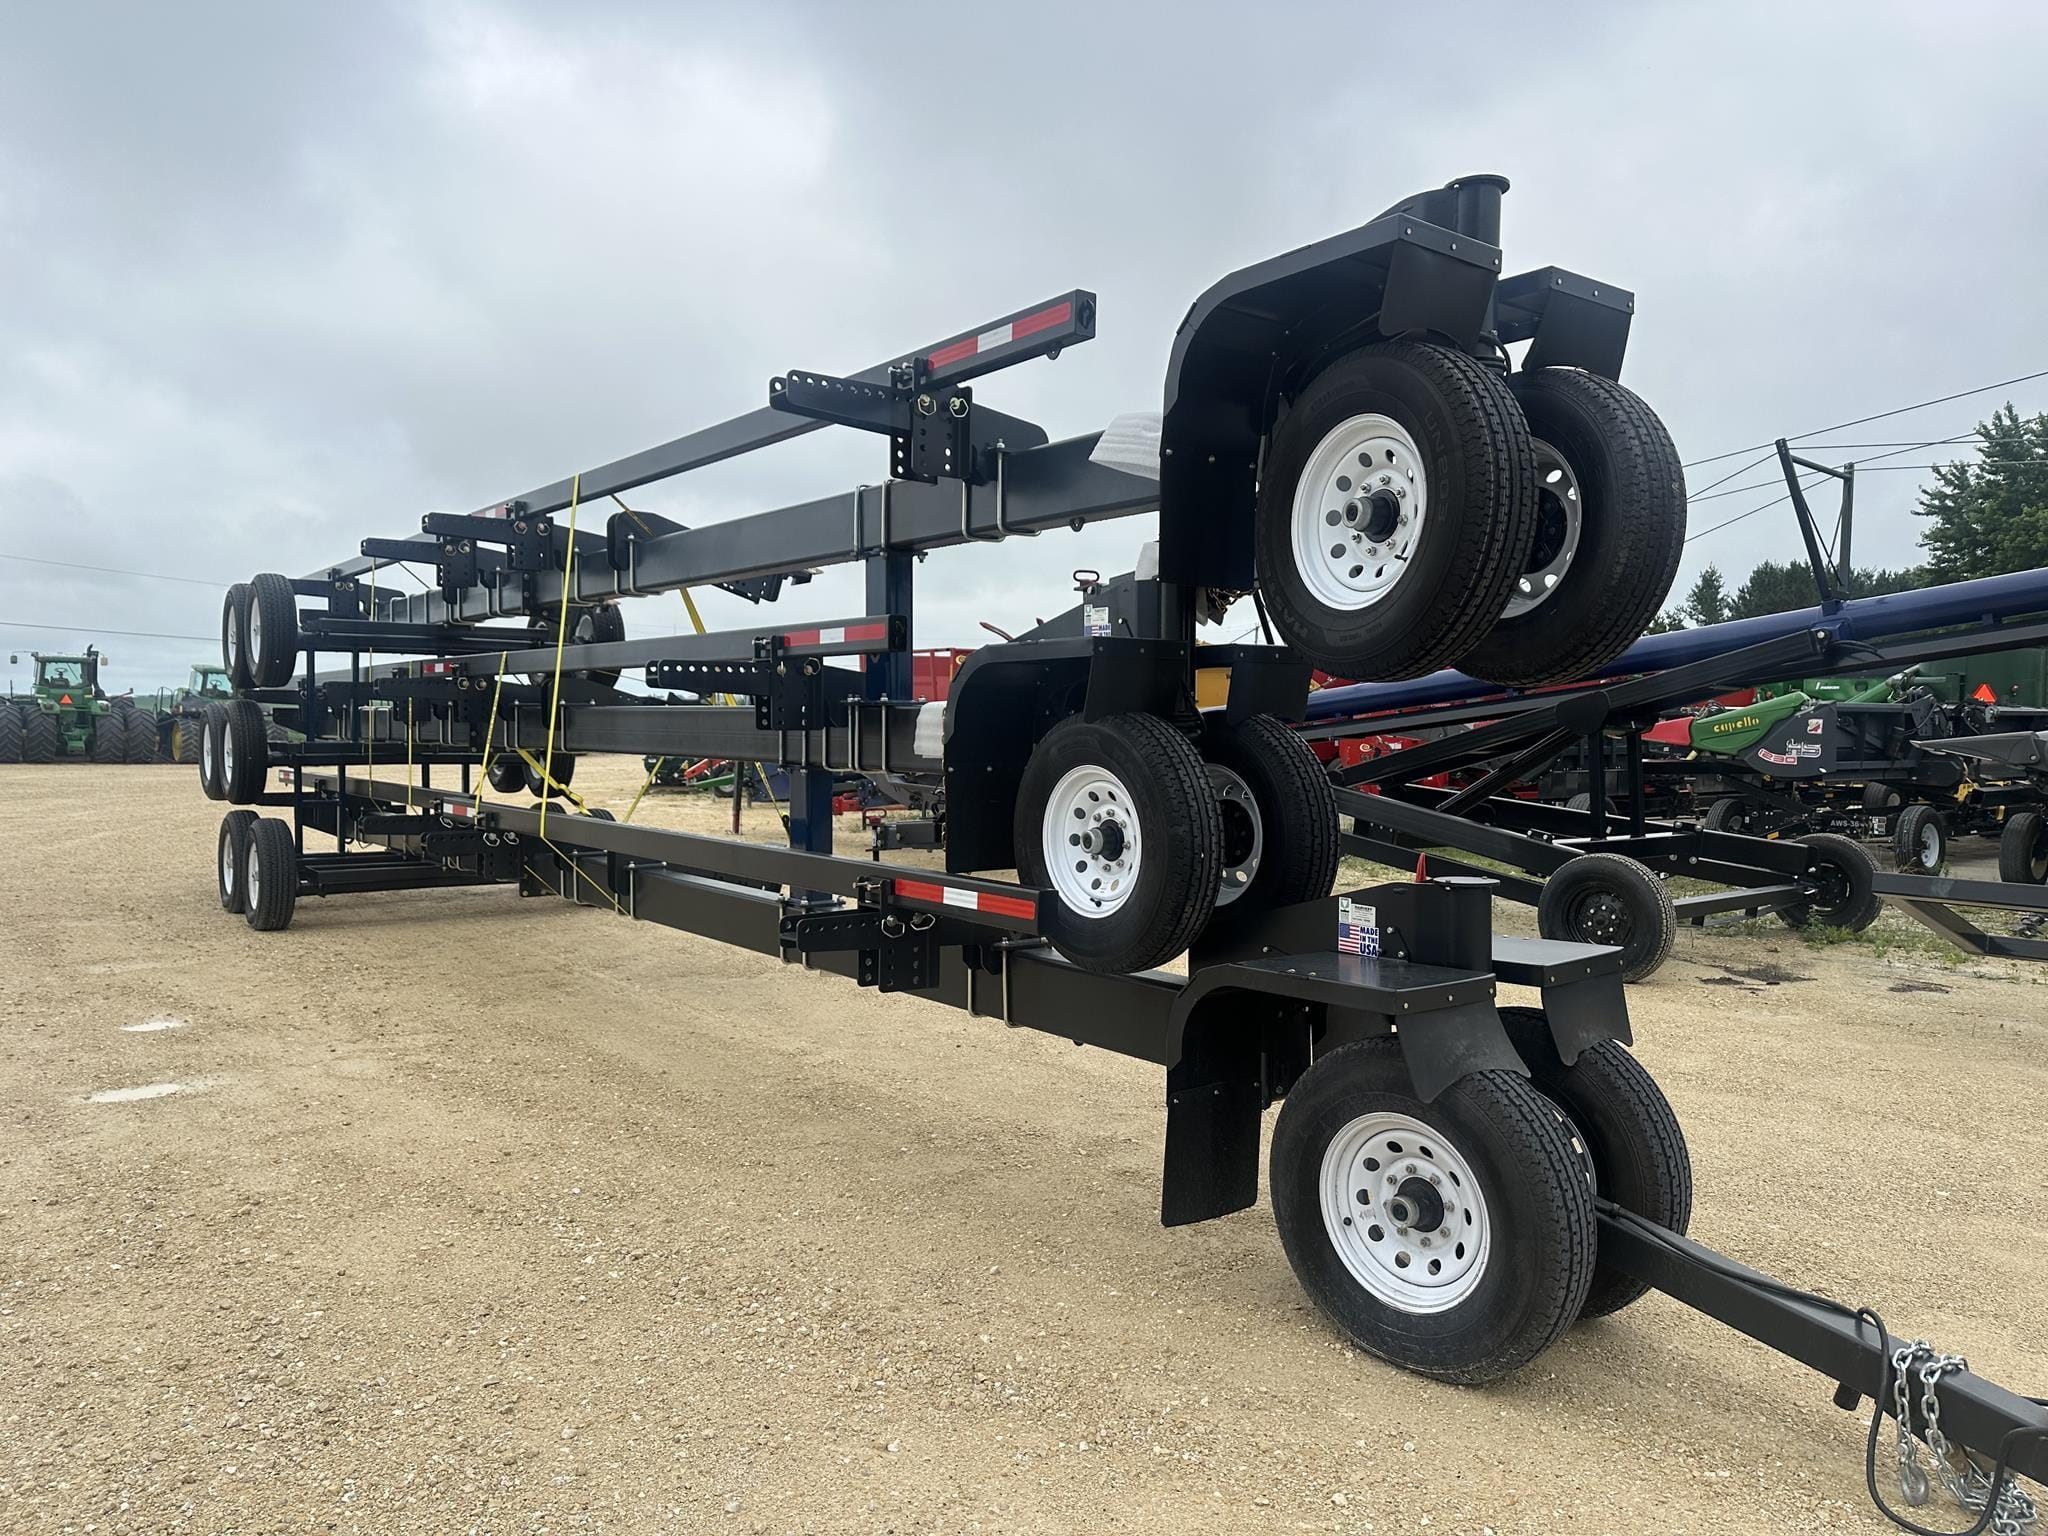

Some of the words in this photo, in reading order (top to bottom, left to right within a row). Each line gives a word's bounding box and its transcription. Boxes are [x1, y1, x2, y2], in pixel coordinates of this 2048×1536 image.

[1713, 716, 1760, 732] capello
[1759, 748, 1796, 764] 1230
[1360, 926, 1378, 936] MADE
[1360, 935, 1366, 943] IN
[1367, 936, 1378, 945] THE
[1360, 943, 1378, 957] USA
